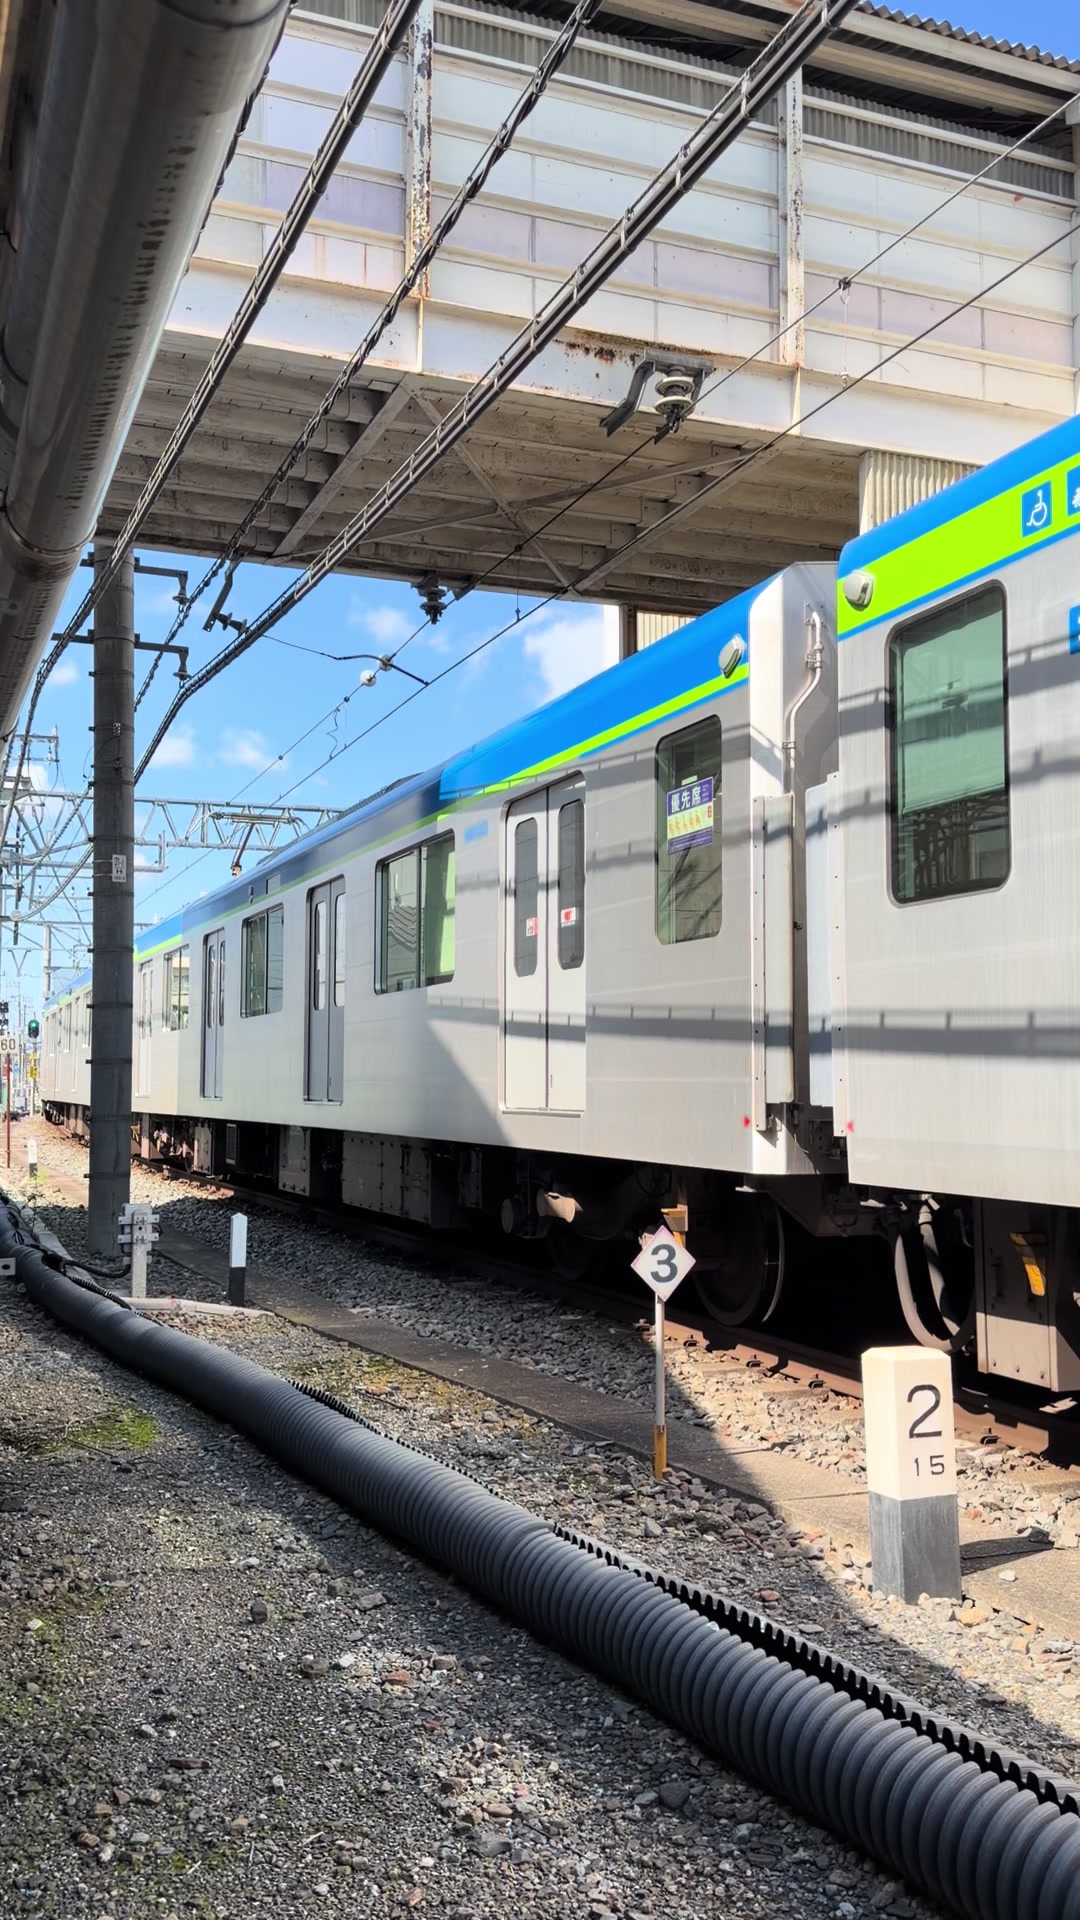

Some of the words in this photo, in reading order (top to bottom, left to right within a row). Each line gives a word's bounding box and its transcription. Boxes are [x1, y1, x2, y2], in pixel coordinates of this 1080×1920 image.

[671, 786, 701, 813] 優先席
[1, 1038, 16, 1051] 60
[650, 1243, 678, 1283] 3
[907, 1384, 942, 1438] 2
[914, 1455, 945, 1476] 15
